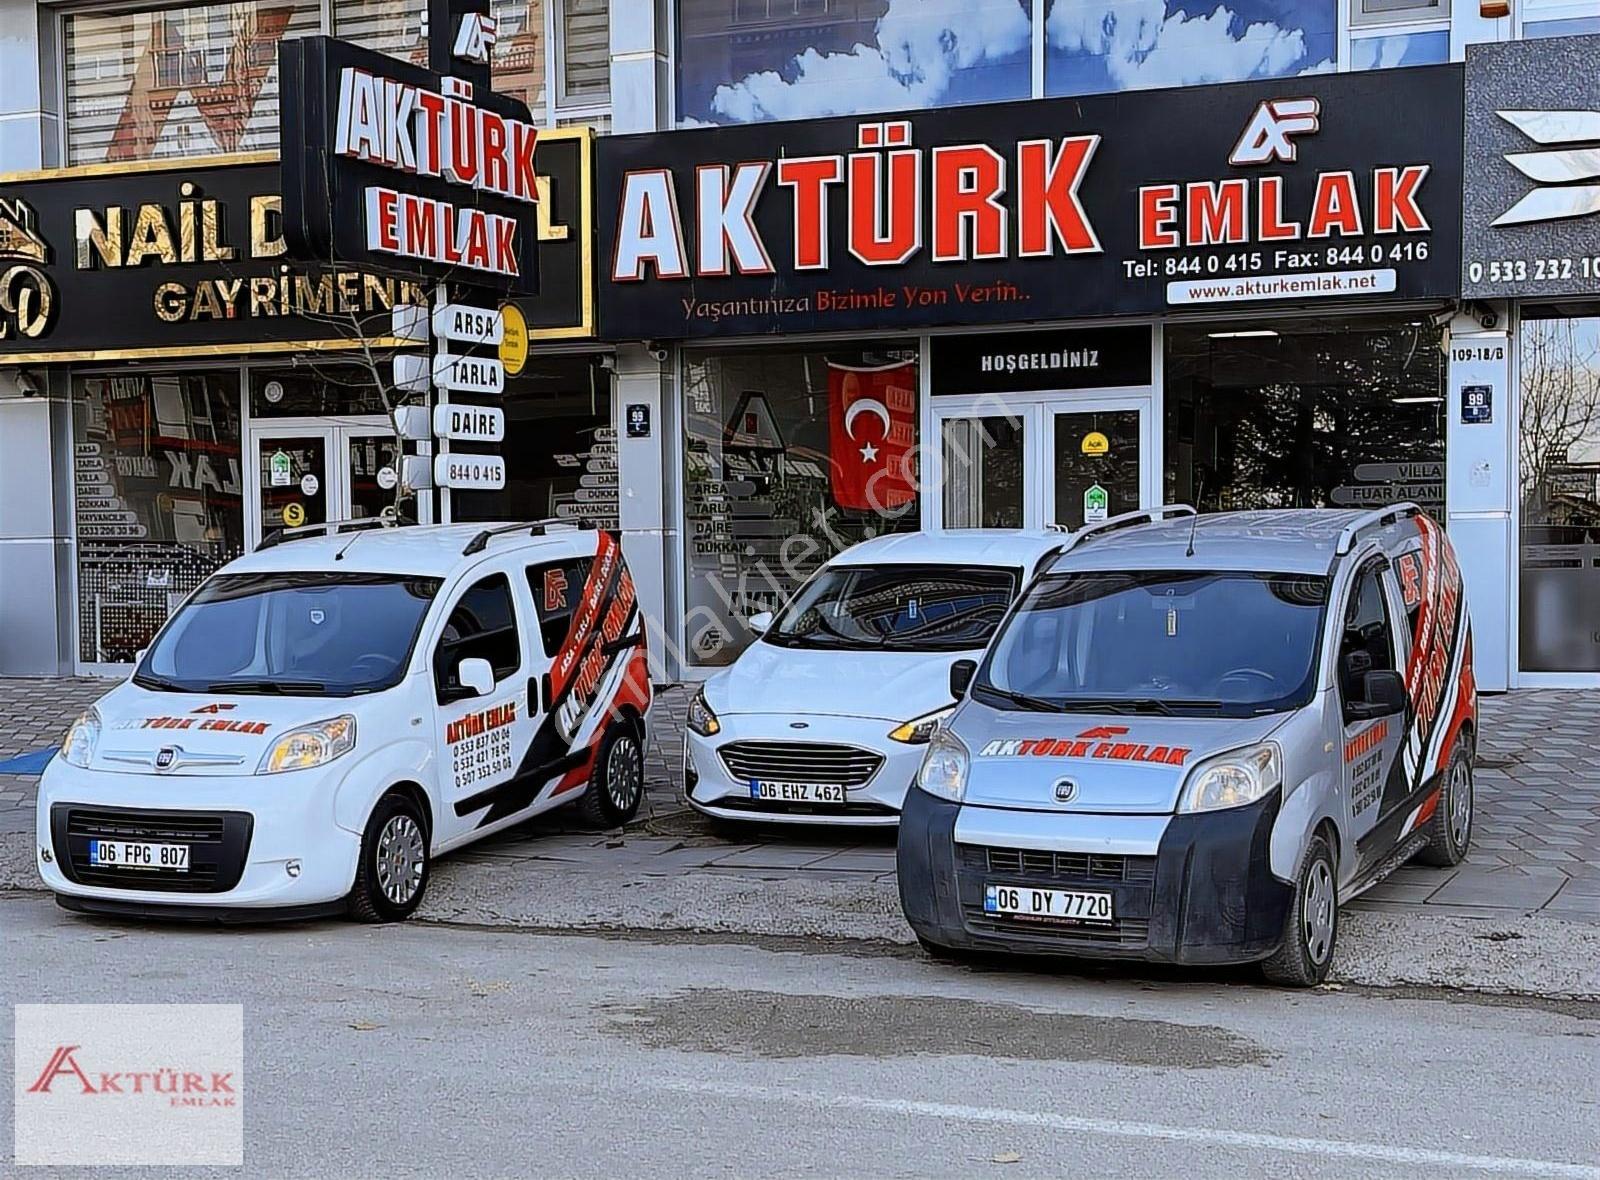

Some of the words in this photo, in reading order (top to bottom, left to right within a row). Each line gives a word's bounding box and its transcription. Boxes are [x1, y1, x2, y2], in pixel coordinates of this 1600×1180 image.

[335, 67, 540, 203] AKTÜRK
[611, 121, 1104, 281] AKTÜRK
[1139, 164, 1431, 249] EMLAK
[75, 181, 237, 269] NAİL
[365, 187, 520, 277] EMLAK
[1123, 259, 1158, 278] Tel:
[1166, 257, 1201, 275] 844
[1208, 255, 1219, 272] 0
[1225, 253, 1262, 271] 415
[1275, 250, 1318, 268] Fax:
[1326, 247, 1364, 265] 844
[1371, 245, 1382, 263] 0
[1390, 242, 1428, 260] 416
[1469, 262, 1483, 283] 0
[1490, 260, 1527, 282] 533
[1534, 259, 1572, 280] 232
[1188, 274, 1377, 299] www.akturkemlak.net
[817, 288, 896, 311] Bizimle
[454, 311, 494, 337] ARSA
[981, 348, 1099, 373] HOŞGELDİNİZ
[1452, 347, 1503, 361] 109-18/B
[452, 362, 498, 387] TARLA
[452, 409, 495, 435] DAİRE
[450, 465, 470, 480] 844
[473, 465, 480, 481] 0
[483, 466, 501, 482] 415
[694, 484, 728, 495] ARSA
[1352, 487, 1393, 500] FUAR
[1397, 486, 1442, 499] ALANI
[289, 506, 299, 519] S
[694, 502, 733, 514] TARLA
[696, 520, 733, 534] DAİRE
[980, 737, 1094, 757] AKTÜRK
[1091, 742, 1192, 767] EMLAK
[760, 783, 776, 798] 06
[782, 784, 808, 799] EHZ
[815, 785, 841, 801] 462
[99, 844, 116, 862] 06
[125, 845, 151, 864] FPG
[161, 847, 187, 865] 807
[998, 889, 1019, 909] 06
[1032, 891, 1053, 913] DY
[1064, 894, 1109, 916] 7720
